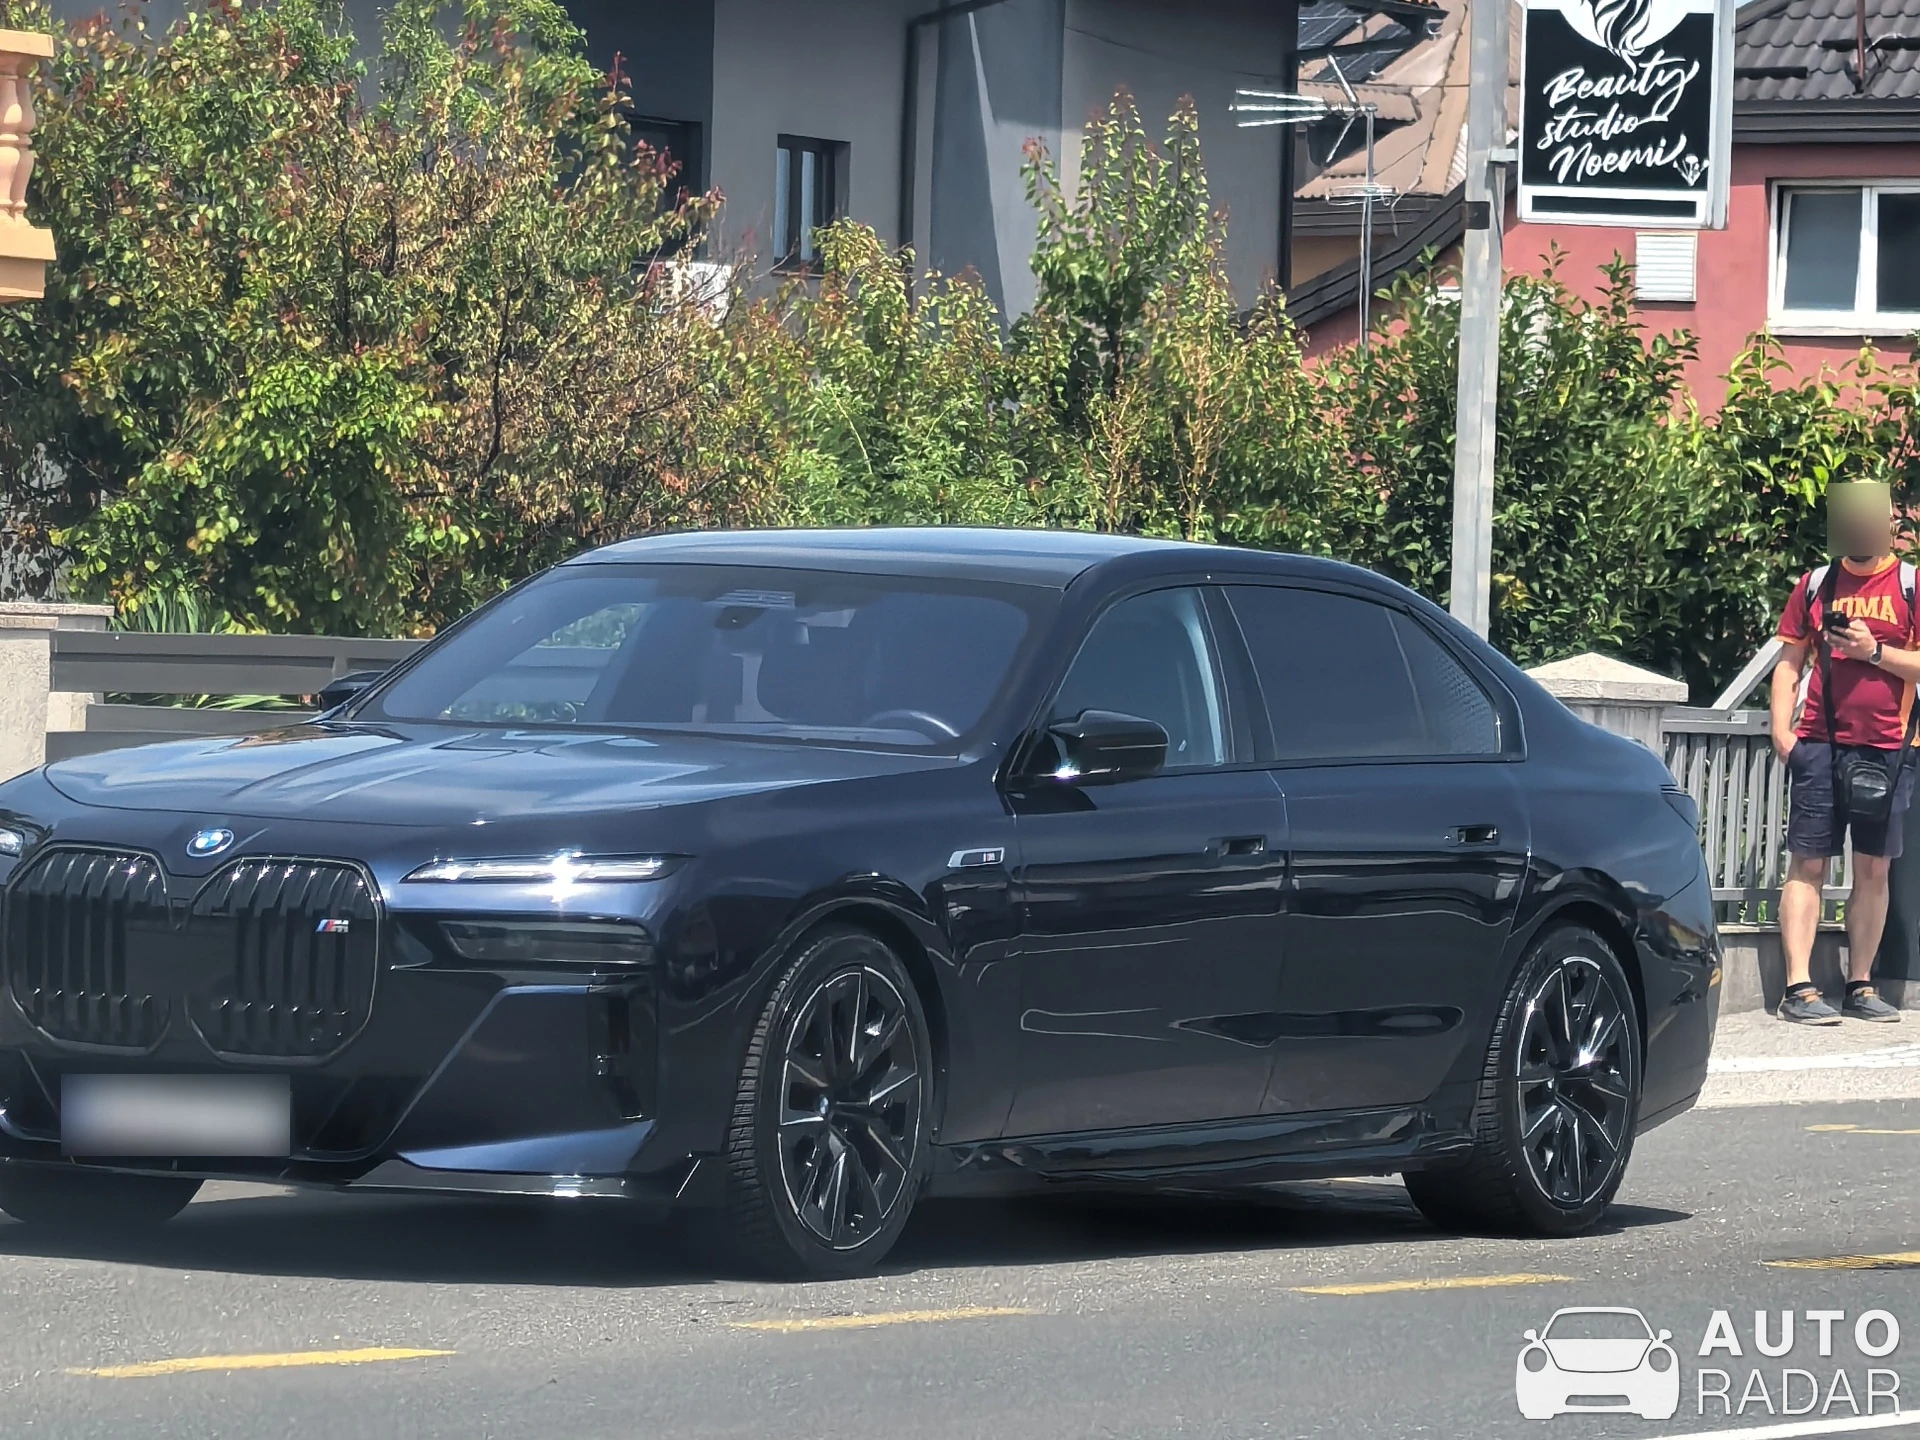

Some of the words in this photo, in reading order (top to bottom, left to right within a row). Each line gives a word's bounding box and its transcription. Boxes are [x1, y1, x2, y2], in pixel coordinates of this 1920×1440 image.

[1543, 50, 1700, 122] Beauty
[1537, 103, 1645, 149] studio
[1549, 134, 1687, 184] Noemi
[1832, 595, 1898, 625] OMA
